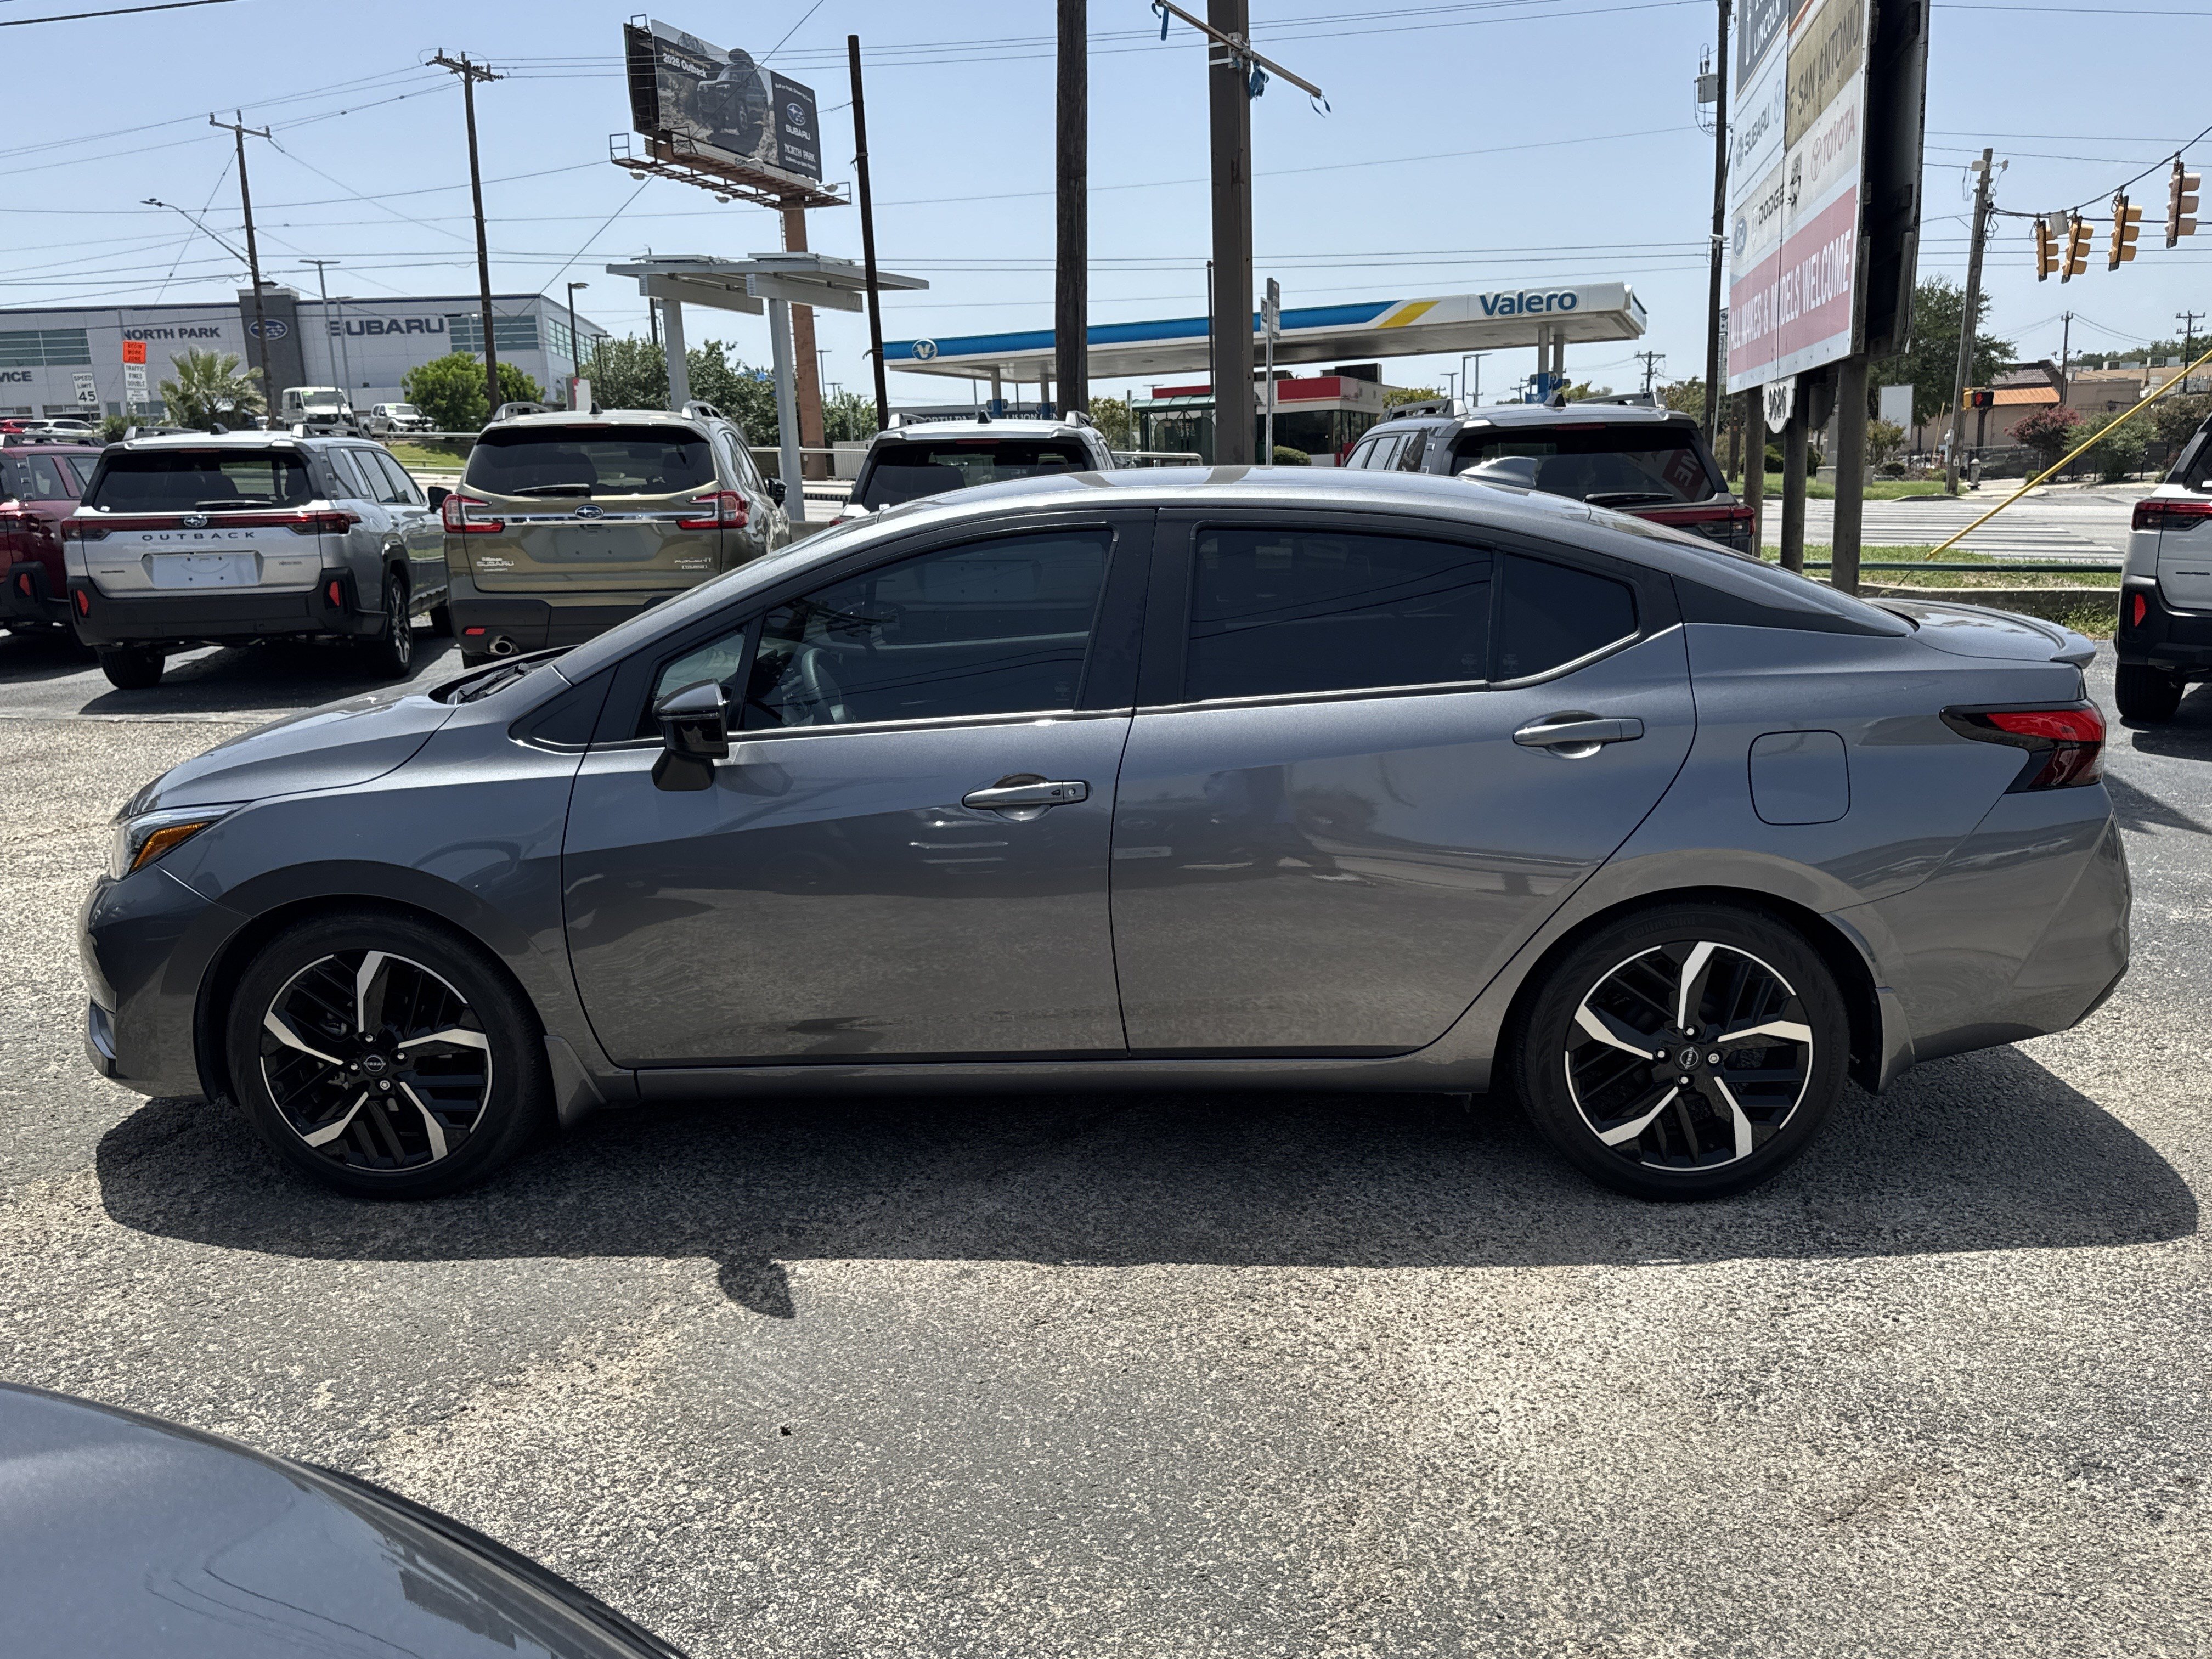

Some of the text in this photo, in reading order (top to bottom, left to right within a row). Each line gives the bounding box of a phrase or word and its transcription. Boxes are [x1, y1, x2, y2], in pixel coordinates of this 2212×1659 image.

[1797, 58, 1815, 116] SAN
[1817, 0, 1860, 92] ANTONIO
[785, 124, 811, 141] SUBARU
[1745, 103, 1770, 157] SUBARU
[1822, 104, 1855, 167] TOYOTA
[1758, 183, 1785, 226] DODGE
[1730, 306, 1741, 352] ALL
[1741, 292, 1762, 347] MAKES
[1802, 228, 1852, 314] WELCOME
[1479, 292, 1577, 316] Valero
[124, 326, 221, 340] NORTH PARK
[329, 318, 444, 336] SUBARU
[78, 390, 96, 402] 45
[142, 531, 256, 541] OUTBACK
